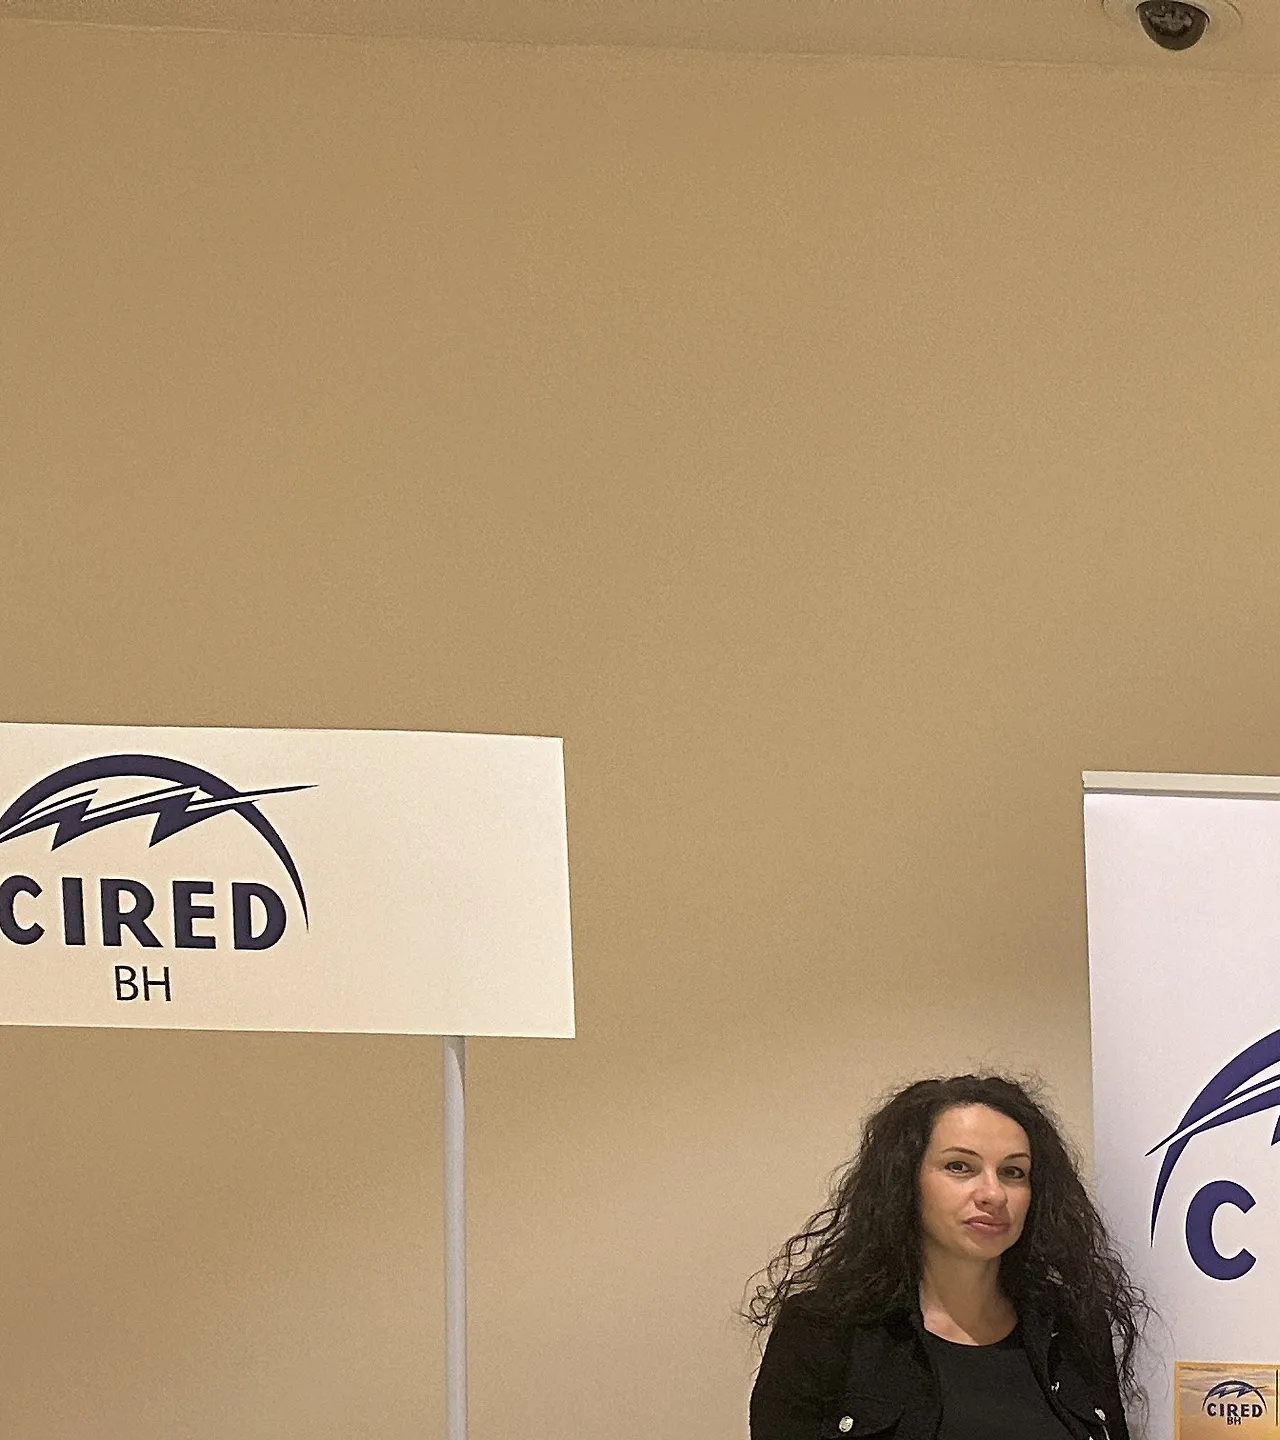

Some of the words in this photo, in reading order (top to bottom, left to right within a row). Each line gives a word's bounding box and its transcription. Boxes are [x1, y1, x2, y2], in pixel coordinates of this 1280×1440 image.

[0, 874, 287, 950] CIRED
[115, 965, 171, 1002] BH
[1207, 1403, 1263, 1417] CIRED
[1227, 1416, 1241, 1425] BH
